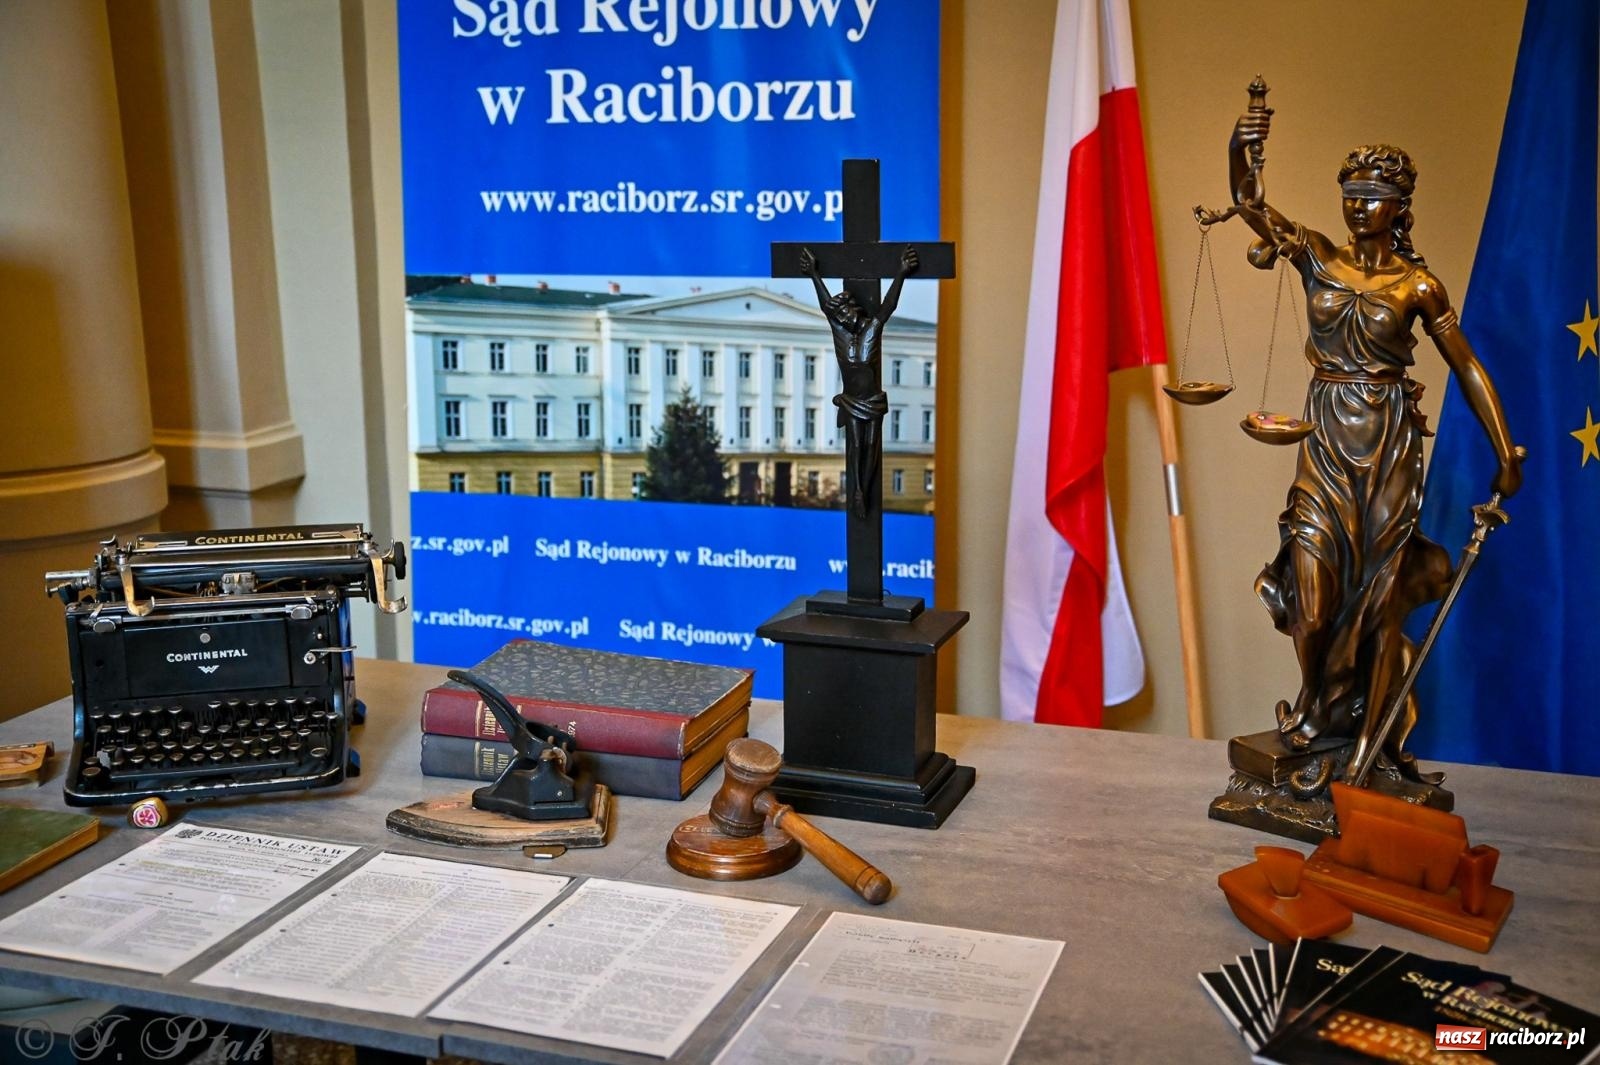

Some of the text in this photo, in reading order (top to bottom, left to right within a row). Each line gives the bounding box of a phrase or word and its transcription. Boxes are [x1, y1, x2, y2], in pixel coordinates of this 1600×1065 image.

[452, 0, 877, 47] Sąd Rejonowy
[477, 66, 855, 125] w Raciborzu
[480, 182, 843, 221] www.raciborz.sr.gov.p
[194, 532, 304, 545] CONTINENTAL
[535, 537, 571, 561] Sąd
[577, 540, 668, 567] Rejonowy
[674, 549, 691, 564] w
[697, 547, 797, 571] Raciborzu
[619, 618, 655, 643] Sąd
[661, 621, 755, 651] Rejonowy
[166, 649, 248, 663] CONTINENTAL
[567, 720, 577, 737] 974
[206, 830, 282, 848] DZIENNIK
[288, 842, 347, 856] USTAW
[1401, 971, 1453, 993] Sąd
